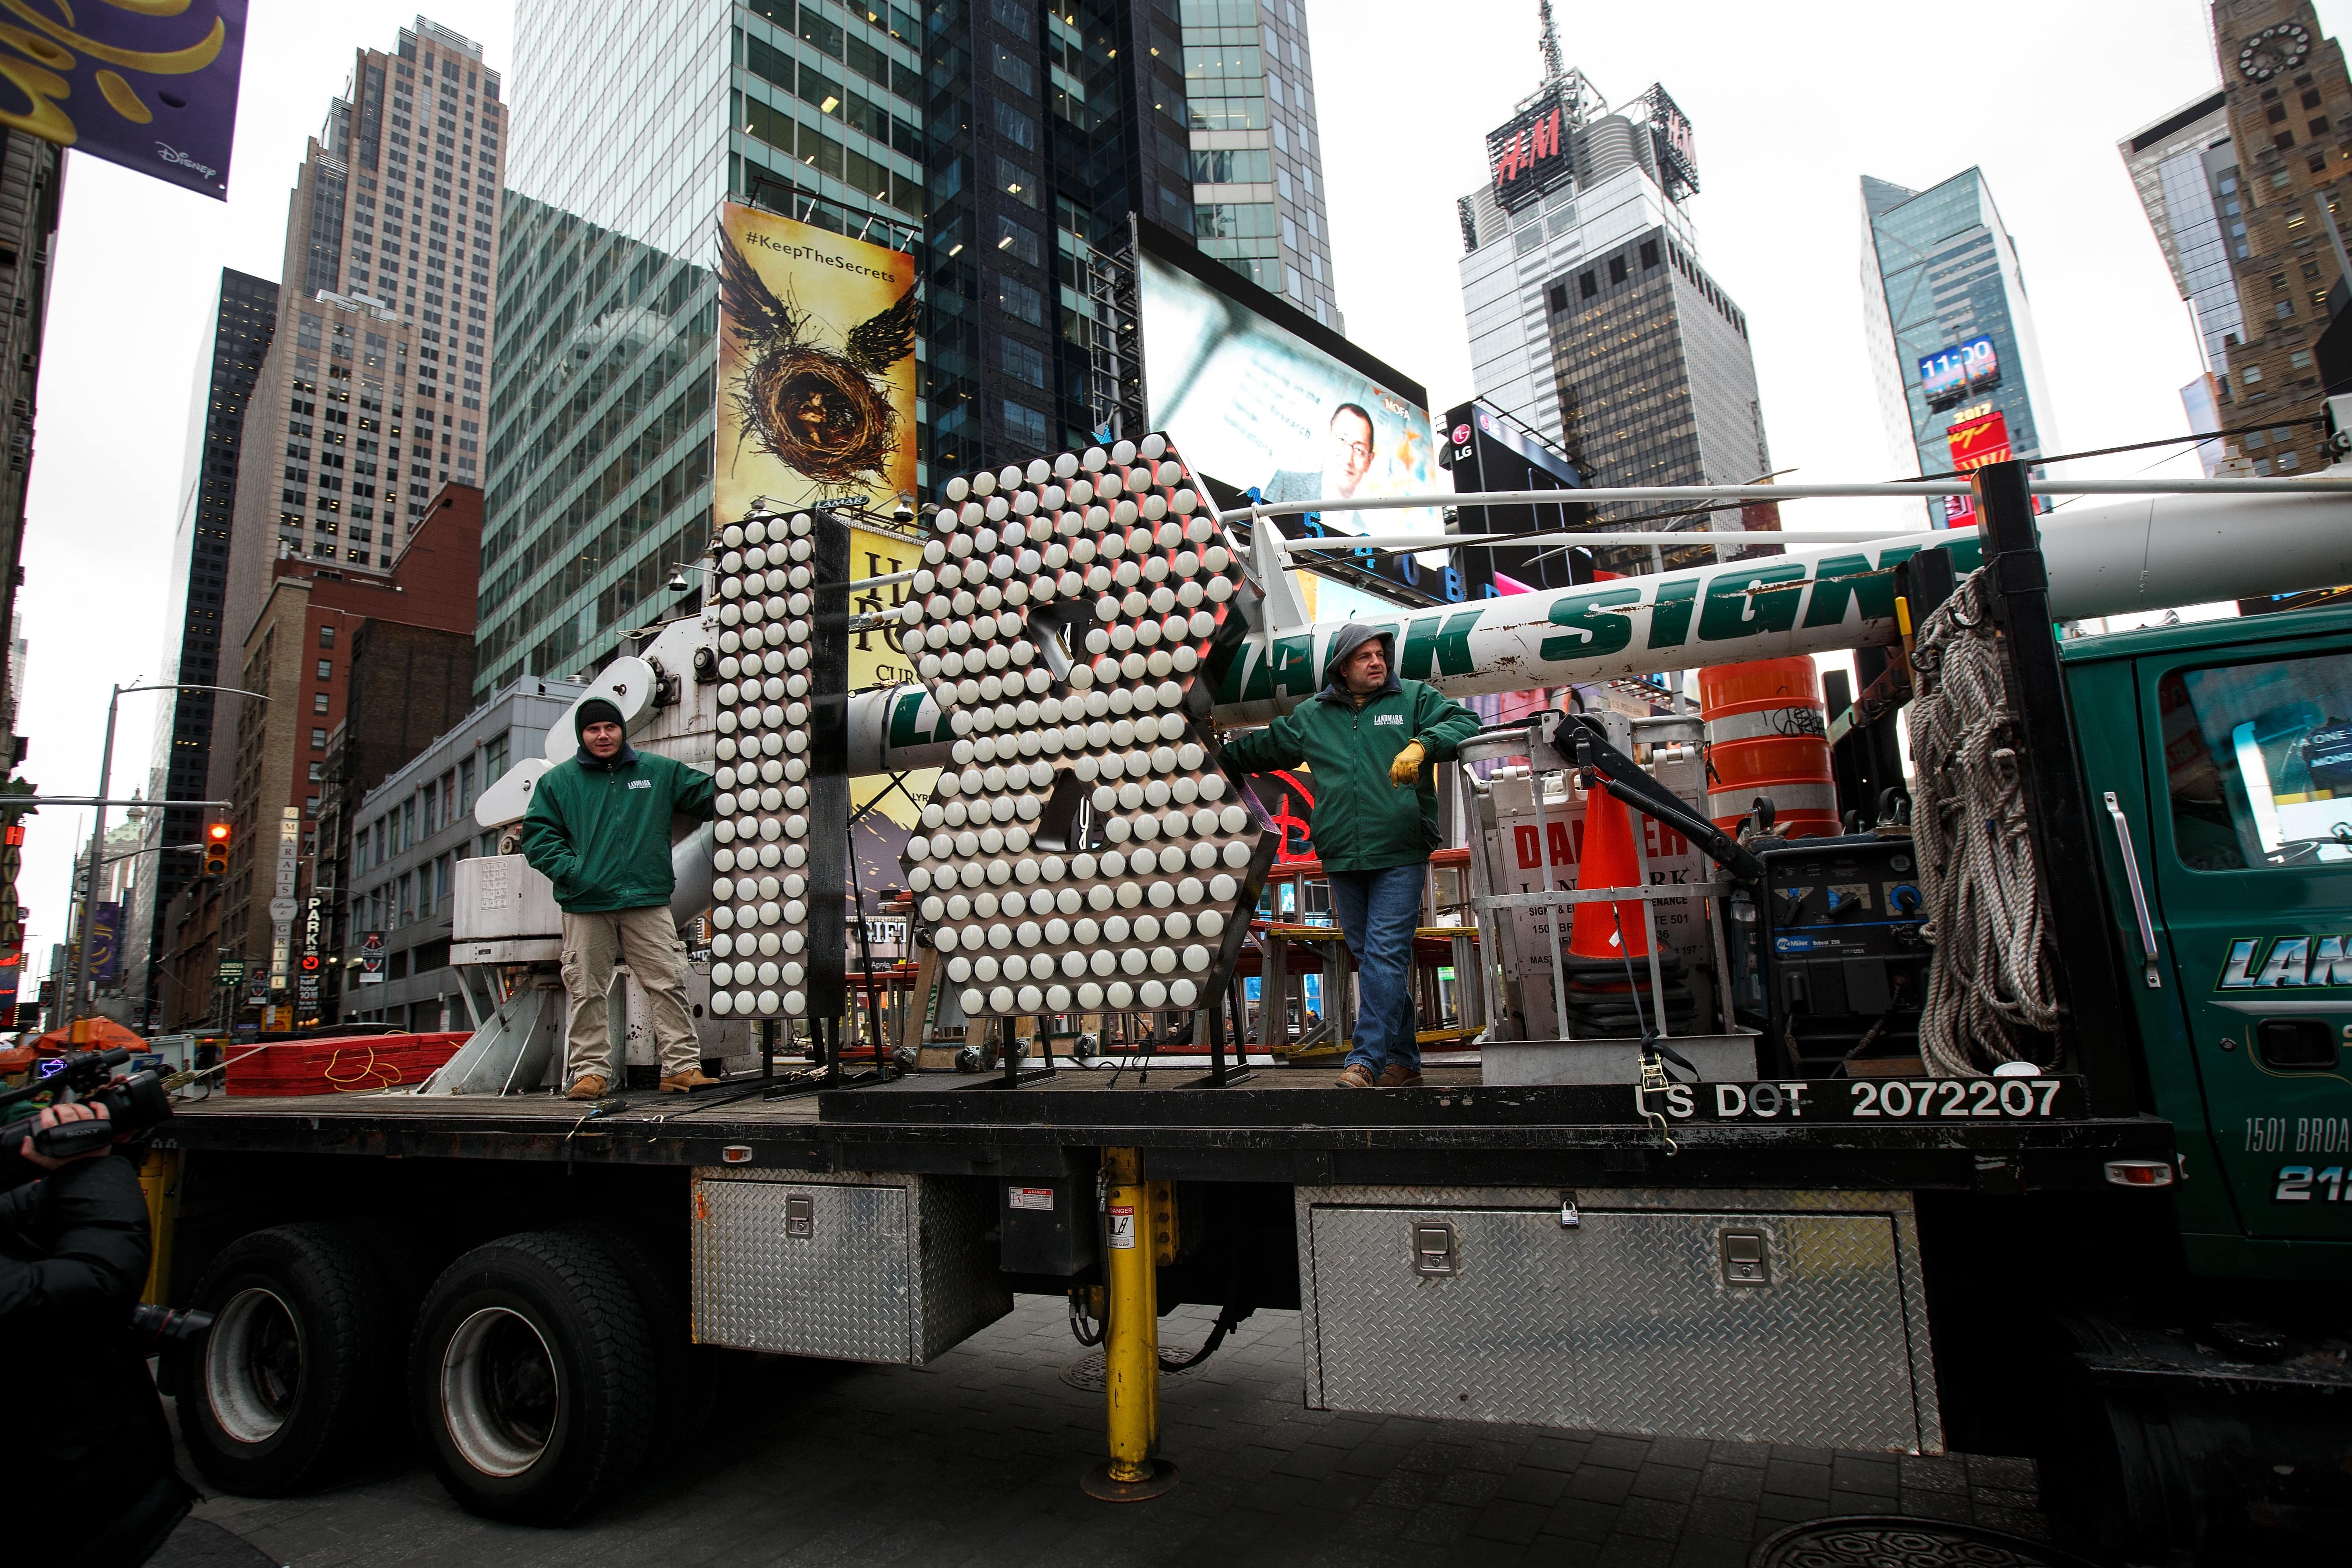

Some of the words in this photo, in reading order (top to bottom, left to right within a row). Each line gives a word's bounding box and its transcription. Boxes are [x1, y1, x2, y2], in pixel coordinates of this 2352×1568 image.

[1497, 108, 1560, 186] H&M
[1667, 109, 1696, 169] H&M
[746, 232, 895, 283] #KeepTheSecrets
[1922, 340, 1991, 378] 11:00
[1385, 399, 1411, 421] MOFA
[1954, 403, 1992, 424] 2017
[1489, 421, 1500, 436] LG
[1948, 411, 2003, 434] TOSHIBA
[1455, 445, 1472, 461] LG
[816, 497, 863, 507] LAMAR
[2313, 729, 2352, 744] ONE-
[2310, 752, 2352, 768] MOND
[912, 793, 932, 802] LYR
[281, 823, 295, 893] MARAIS
[1, 826, 26, 941] HAVANA
[1558, 904, 1565, 914] &
[1671, 914, 1689, 924] 501
[306, 898, 321, 945] PARK
[1532, 925, 1550, 934] 150
[276, 925, 286, 986] GRILL
[1682, 946, 1696, 955] 197
[2217, 936, 2352, 990] LAN
[1635, 1084, 1694, 1118] US
[1716, 1083, 1808, 1117] DOT
[1852, 1080, 2060, 1117] 2072207
[67, 1128, 100, 1138] SONY
[2246, 1118, 2287, 1152] 1501
[2296, 1117, 2352, 1152] BROA
[2276, 1165, 2352, 1202] 21
